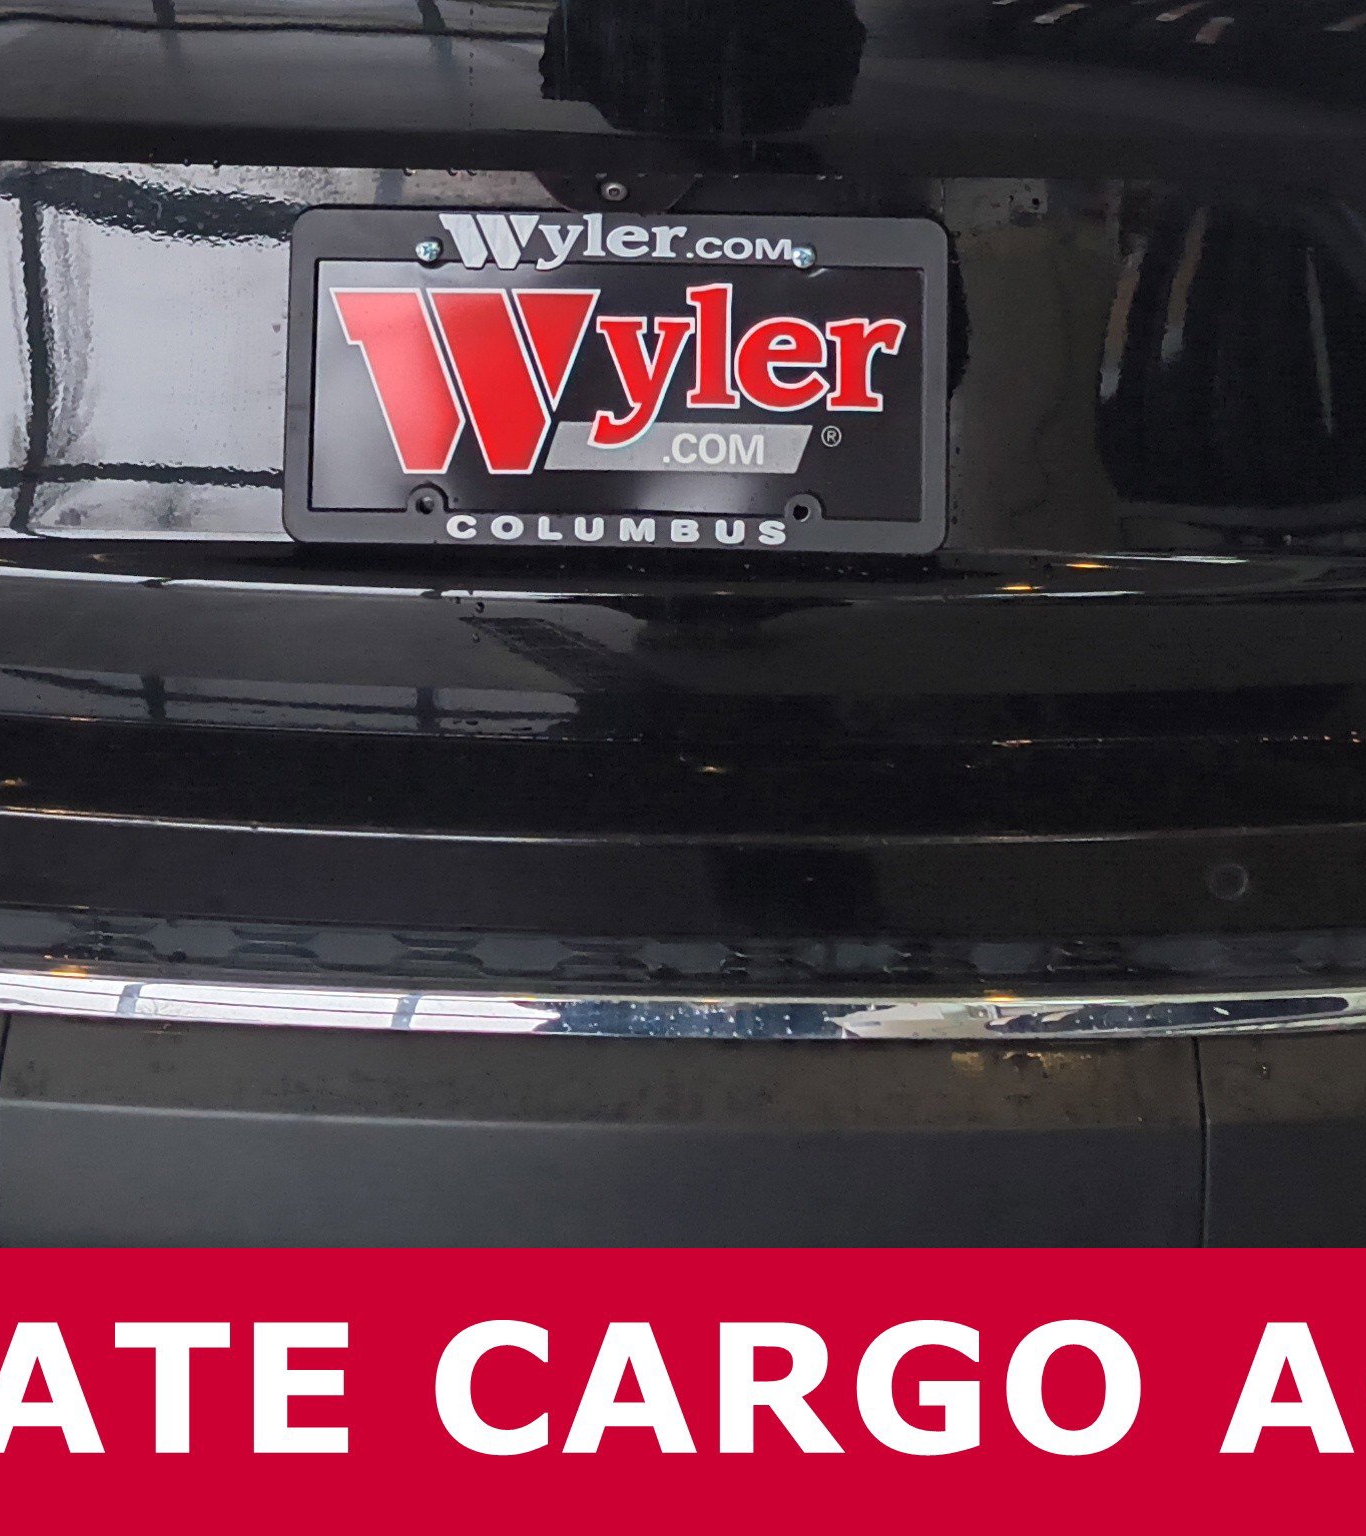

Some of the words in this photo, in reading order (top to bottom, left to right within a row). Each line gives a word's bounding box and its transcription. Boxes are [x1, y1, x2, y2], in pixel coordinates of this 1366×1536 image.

[329, 283, 907, 474] Wyler
[662, 433, 765, 465] .COM
[446, 514, 788, 545] COLUMBUS
